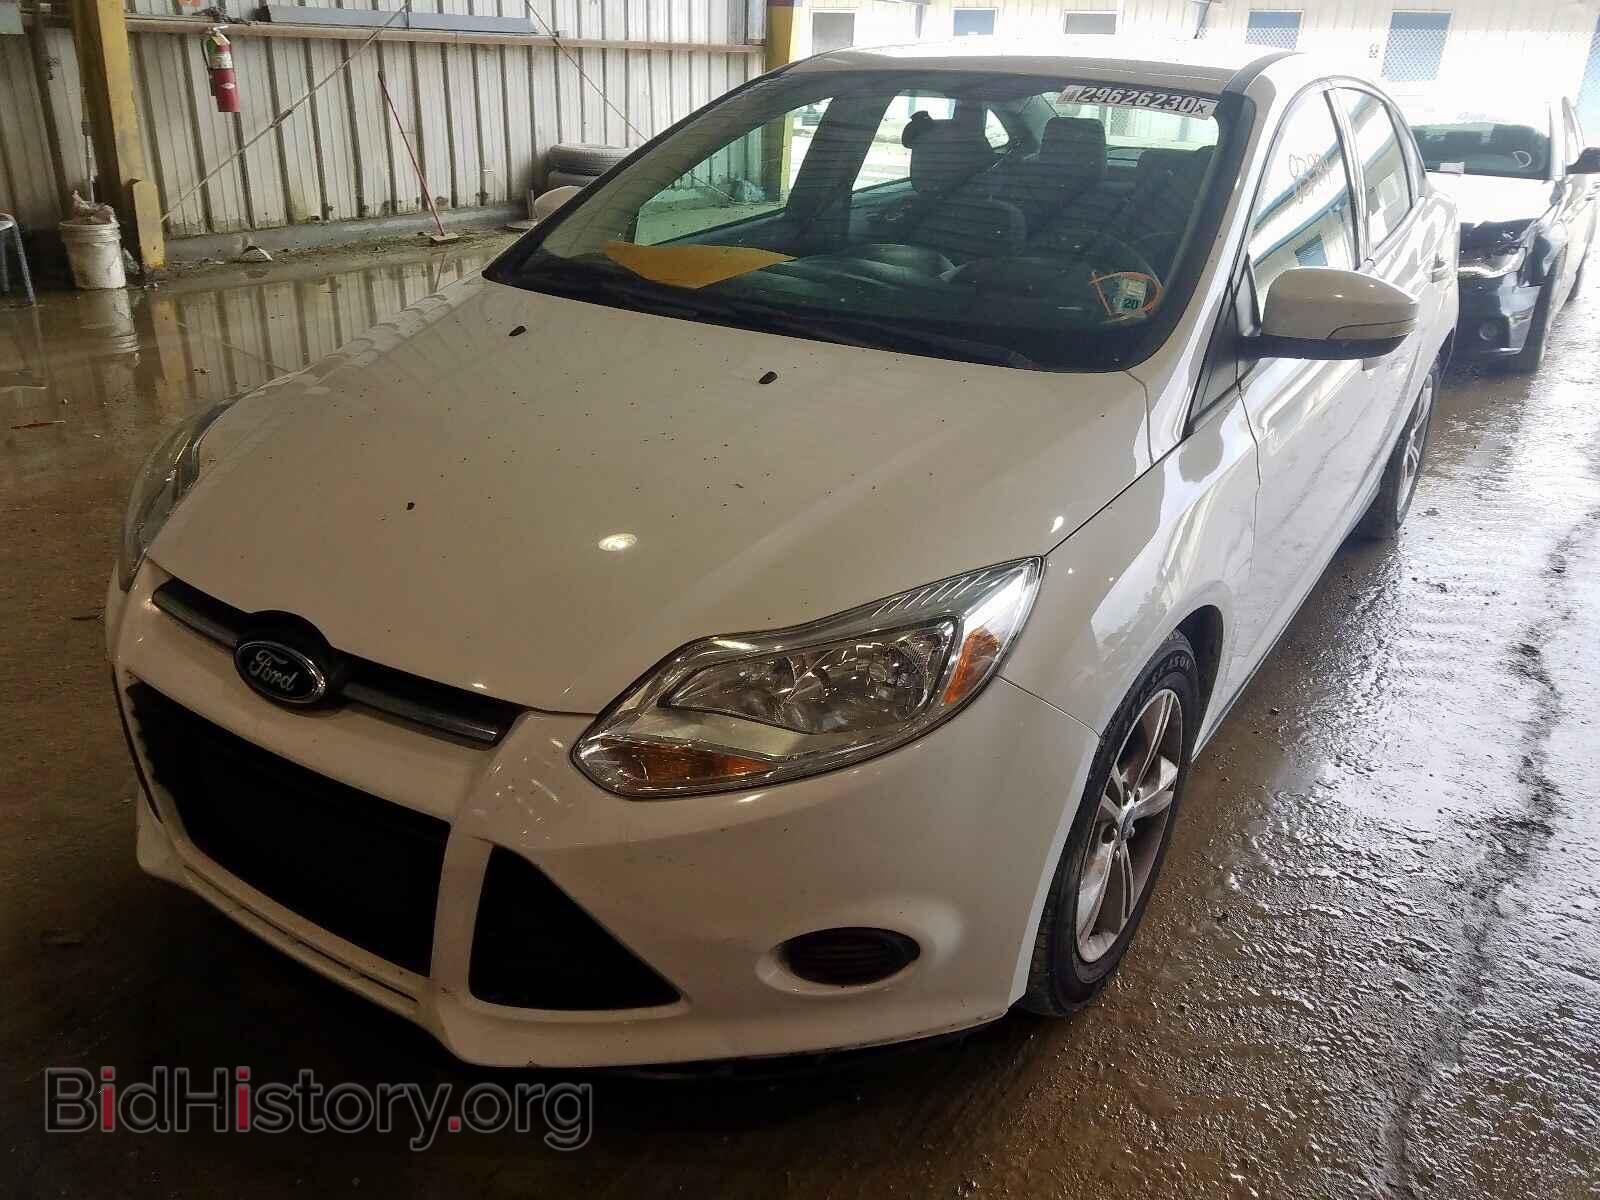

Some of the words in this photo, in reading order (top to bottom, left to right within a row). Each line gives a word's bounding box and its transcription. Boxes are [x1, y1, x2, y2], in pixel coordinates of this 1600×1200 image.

[1079, 87, 1195, 113] 29626230
[1123, 297, 1139, 310] 20
[249, 649, 298, 691] Ford
